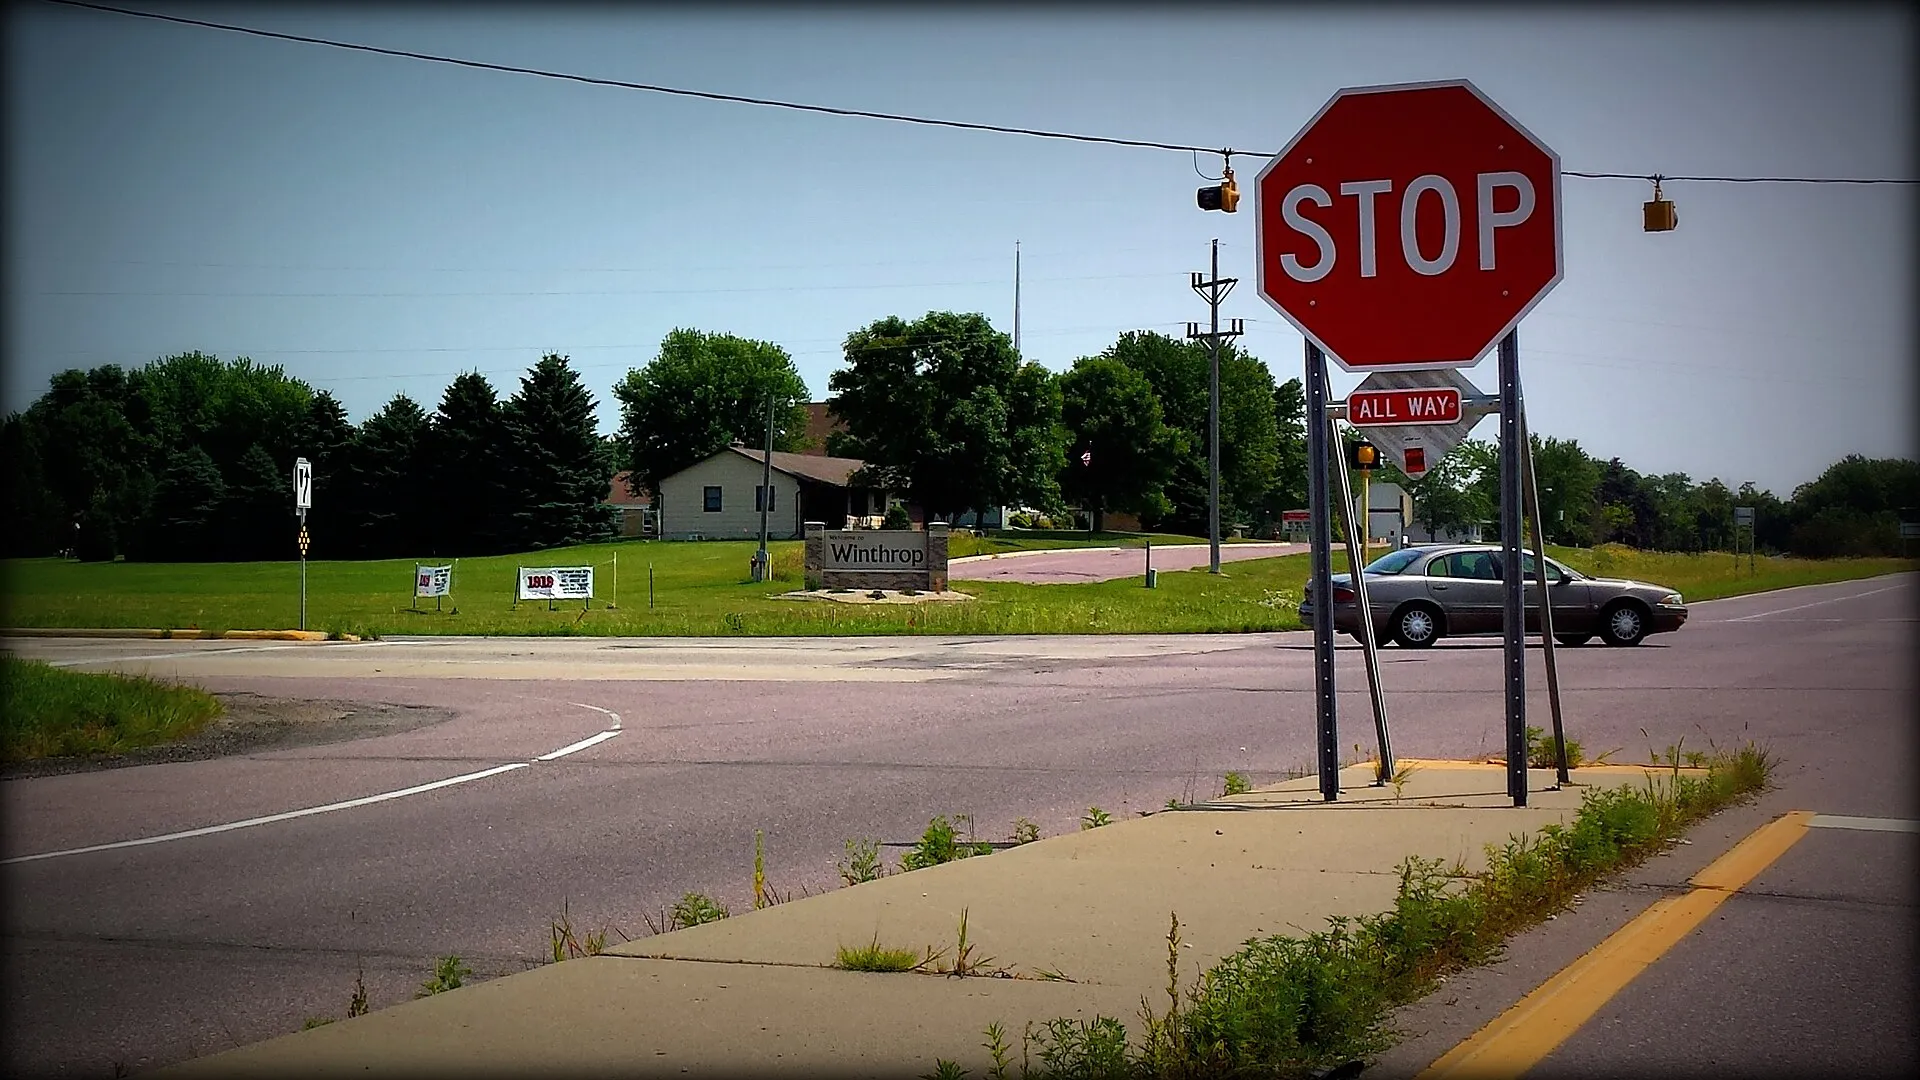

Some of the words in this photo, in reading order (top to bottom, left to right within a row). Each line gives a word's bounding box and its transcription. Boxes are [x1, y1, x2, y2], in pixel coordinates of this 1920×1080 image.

[1280, 171, 1536, 283] STOP
[1360, 398, 1397, 419] ALL
[1407, 395, 1449, 417] WAY
[830, 543, 924, 567] Winthrop
